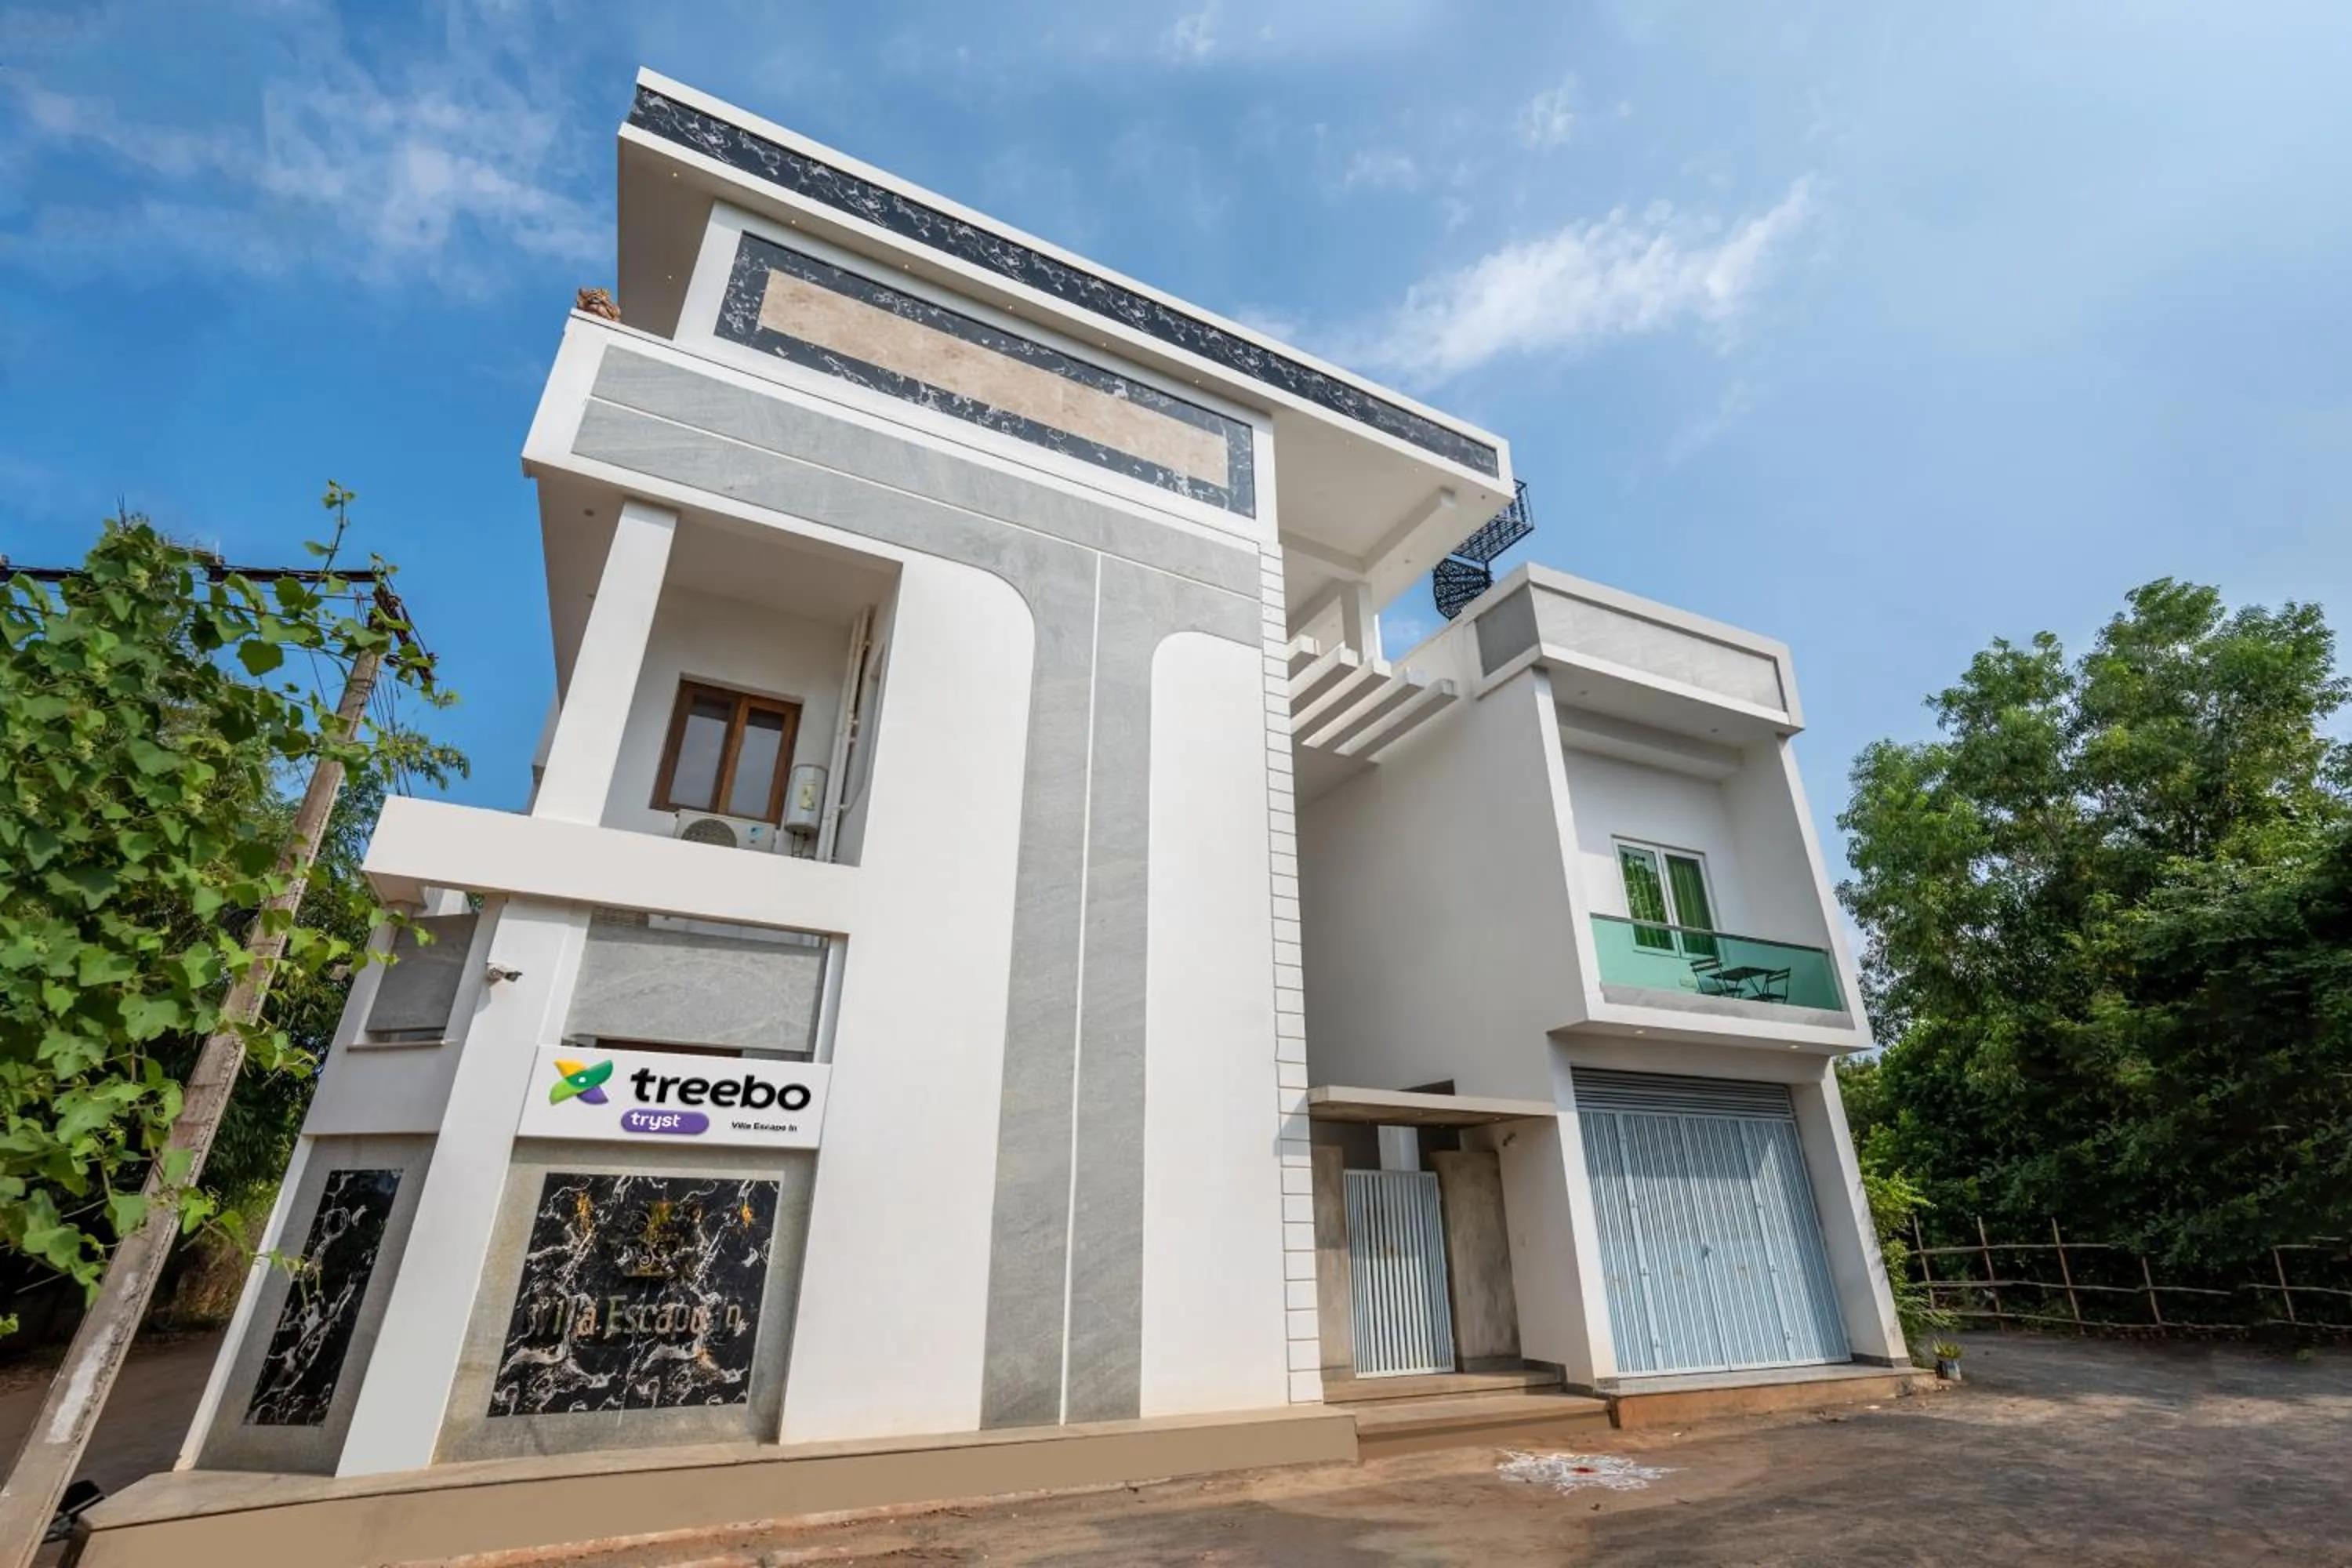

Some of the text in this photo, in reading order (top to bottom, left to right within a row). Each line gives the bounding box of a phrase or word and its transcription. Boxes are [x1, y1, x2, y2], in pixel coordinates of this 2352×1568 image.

[630, 1067, 811, 1110] treebo
[630, 1112, 681, 1131] tryst
[753, 1122, 786, 1131] Escape
